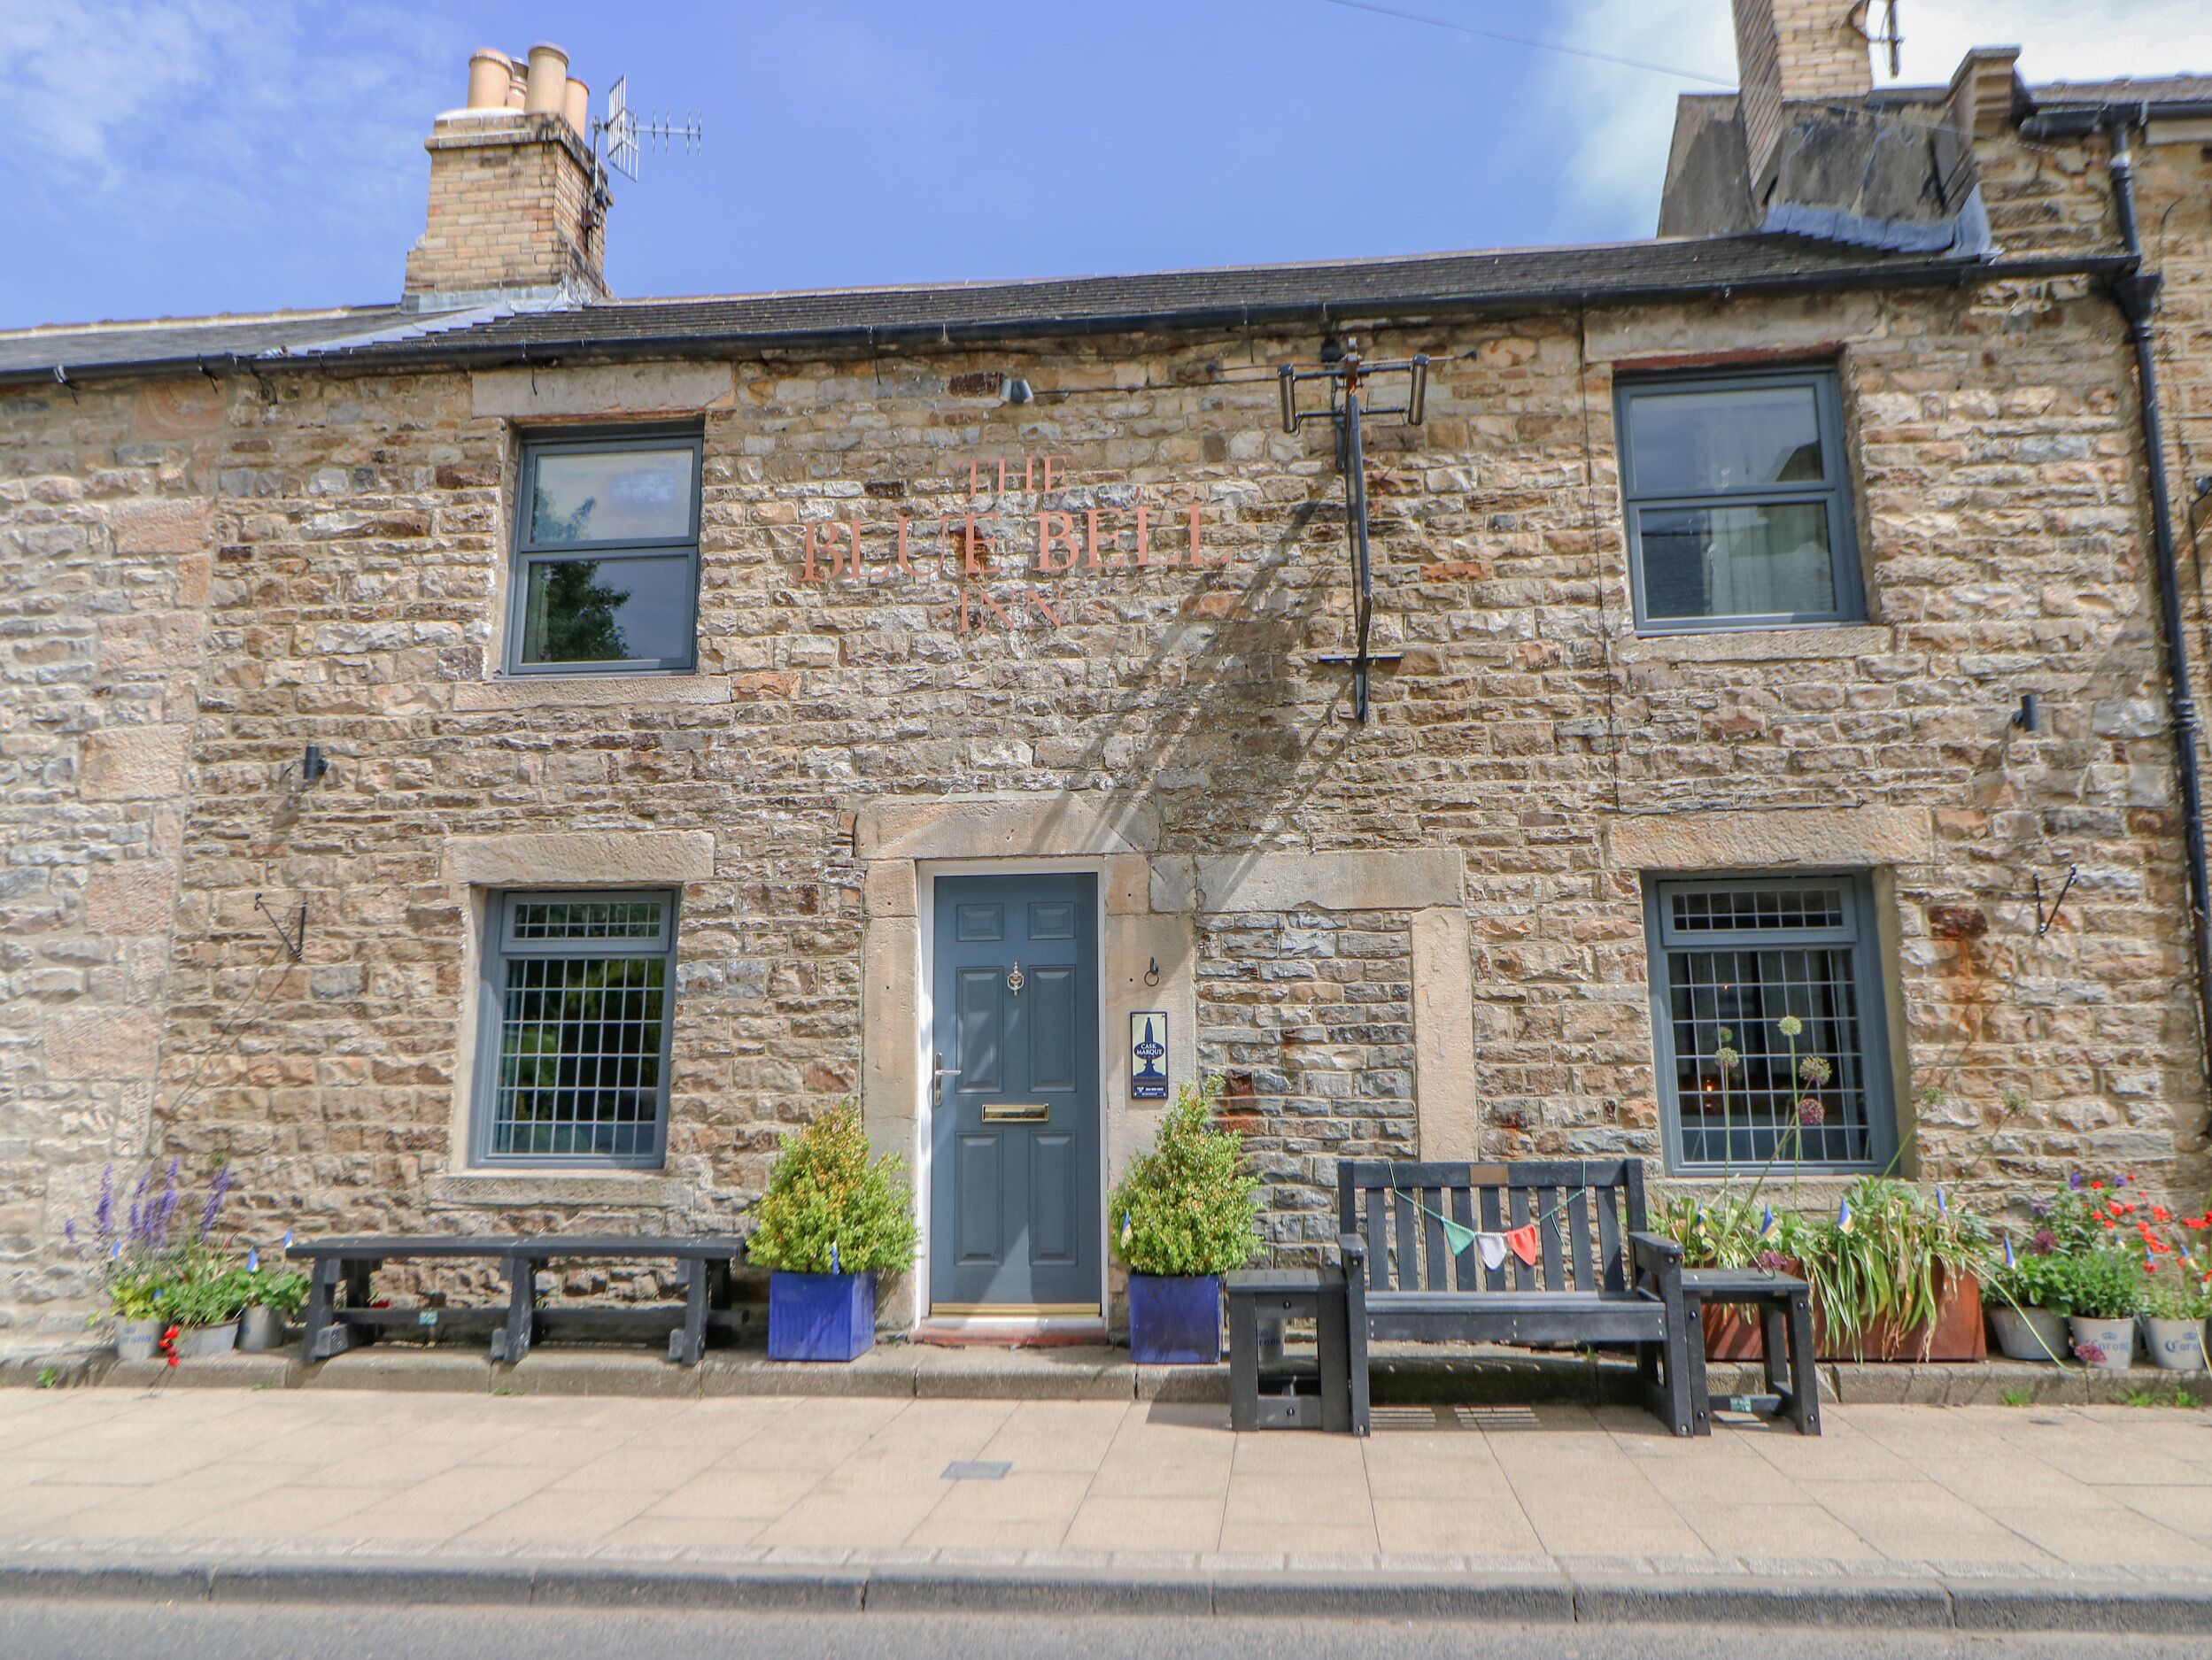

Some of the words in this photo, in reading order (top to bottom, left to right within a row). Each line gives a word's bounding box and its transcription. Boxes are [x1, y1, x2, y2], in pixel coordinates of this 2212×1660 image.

[956, 453, 1070, 498] THE
[800, 512, 1001, 582] BLUE
[1032, 503, 1232, 571] BELL
[959, 586, 1063, 631] INN
